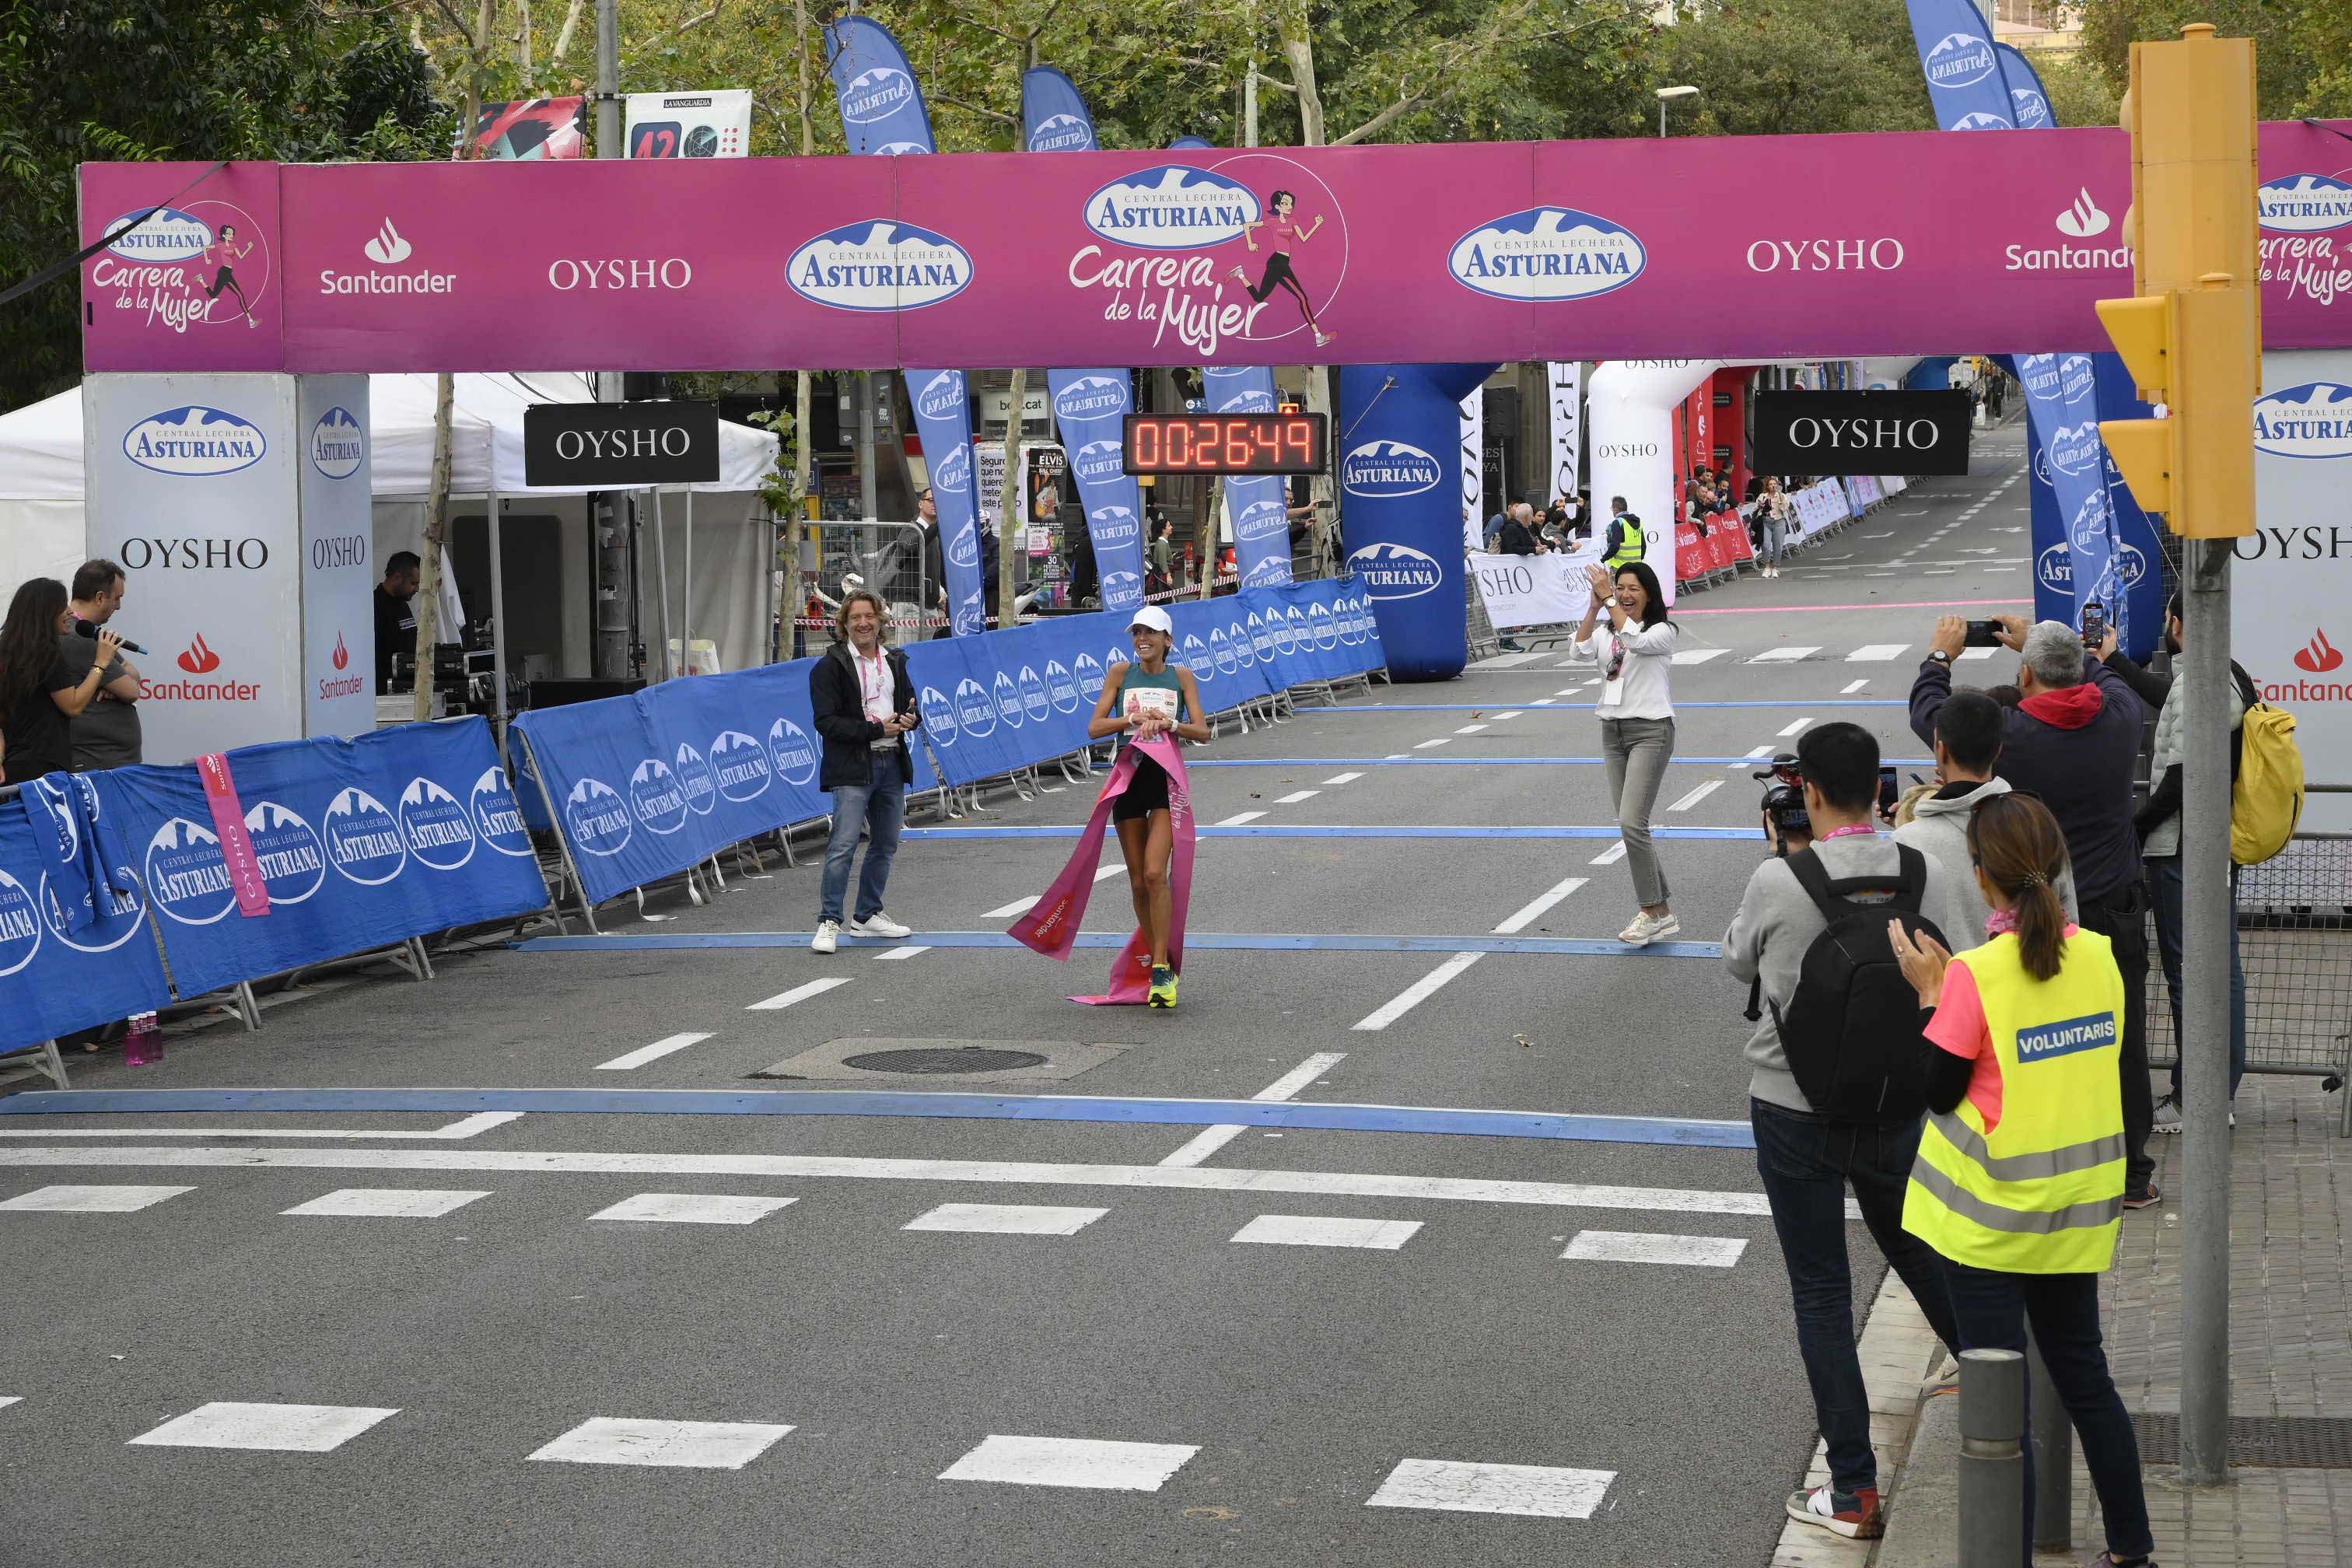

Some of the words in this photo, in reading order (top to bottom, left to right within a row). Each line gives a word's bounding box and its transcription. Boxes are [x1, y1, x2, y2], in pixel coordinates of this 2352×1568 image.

[1125, 194, 1180, 203] CENTRAL
[1185, 193, 1242, 202] LECHERA
[1097, 197, 1245, 228] ASTURIANA
[110, 228, 205, 247] ASTURIANA
[1494, 240, 1555, 250] CENTRAL
[1562, 238, 1624, 248] LECHERA
[2259, 237, 2333, 259] arrera
[829, 250, 887, 261] CENTRAL
[893, 250, 953, 260] LECHERA
[1069, 245, 1214, 289] Carrera
[1464, 243, 1631, 278] ASTURIANA
[1747, 238, 1905, 272] OYSHO
[2005, 243, 2134, 270] Santand
[93, 259, 184, 287] Carrera
[320, 270, 457, 293] Santander
[548, 258, 691, 289] OYSHO
[800, 254, 959, 287] ASTURIANA
[2277, 260, 2291, 282] la
[2287, 255, 2352, 306] Muje
[116, 289, 133, 309] de
[136, 289, 149, 309] la
[146, 285, 219, 333] Mujer
[1104, 290, 1131, 320] de
[1137, 289, 1157, 320] la
[1153, 283, 1269, 355] Mujer
[135, 432, 256, 458] ASTURIANA
[315, 434, 360, 461] ASTURIANA
[555, 427, 691, 460] OYSHO
[1136, 422, 1310, 465] 00:26:49
[1789, 418, 1939, 450] OYSHO
[1039, 455, 1063, 465] ELVIS
[1598, 443, 1658, 458] OYSHO
[981, 468, 994, 477] que
[1346, 462, 1433, 485] ASTURIANA
[982, 499, 997, 507] este
[121, 538, 268, 569] OYSHO
[313, 534, 365, 569] OYSHO
[2232, 526, 2352, 561] OYSH
[1048, 555, 1057, 565] 30
[1363, 570, 1434, 585] TURIANA
[1482, 565, 1533, 597] SHO
[138, 679, 261, 701] Santander
[320, 675, 362, 700] Santander
[411, 810, 436, 821] CENTRAL
[436, 806, 459, 817] LECHERA
[485, 797, 510, 809] CENTRAL
[339, 820, 366, 832] CENTRAL
[367, 817, 390, 828] LECHERA
[405, 814, 472, 851] ASTURIANA
[252, 837, 280, 850] CENTRAL
[281, 831, 310, 845] LECHERA
[331, 827, 403, 865] ASTURIANA
[163, 855, 192, 869] CENTRAL
[194, 849, 224, 863] LECHERA
[229, 824, 256, 898] OYSHO
[257, 845, 322, 880] STURIANA
[156, 862, 234, 904] ASTURIANA
[2019, 1020, 2115, 1054] VOLUNTARIS
